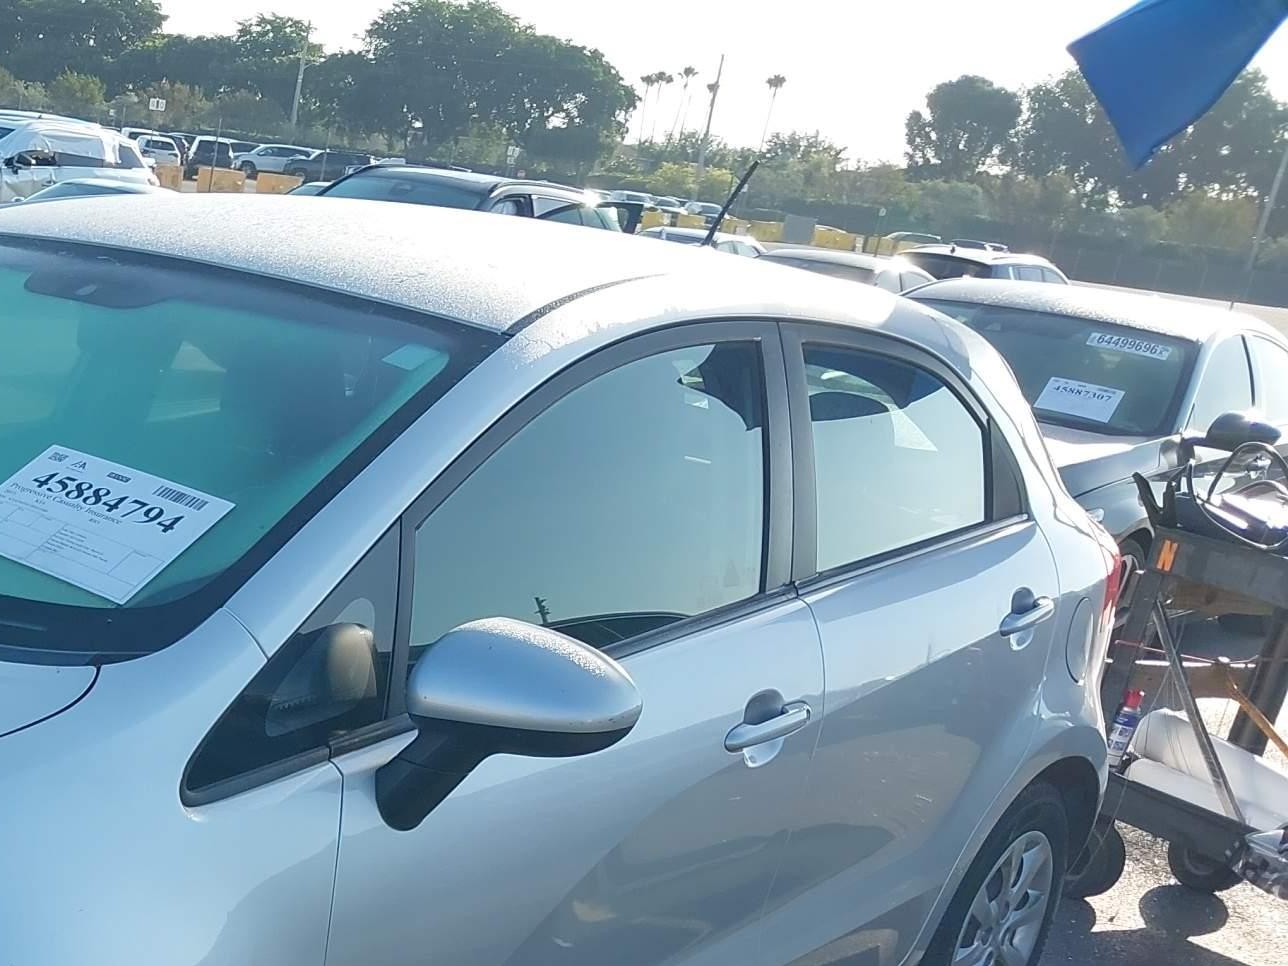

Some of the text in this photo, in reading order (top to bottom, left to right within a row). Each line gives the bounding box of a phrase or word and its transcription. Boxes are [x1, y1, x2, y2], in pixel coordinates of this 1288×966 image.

[9, 482, 53, 501] Progressive
[51, 496, 84, 512] Casualty
[84, 507, 124, 525] Insurance
[31, 471, 185, 534] 45884794
